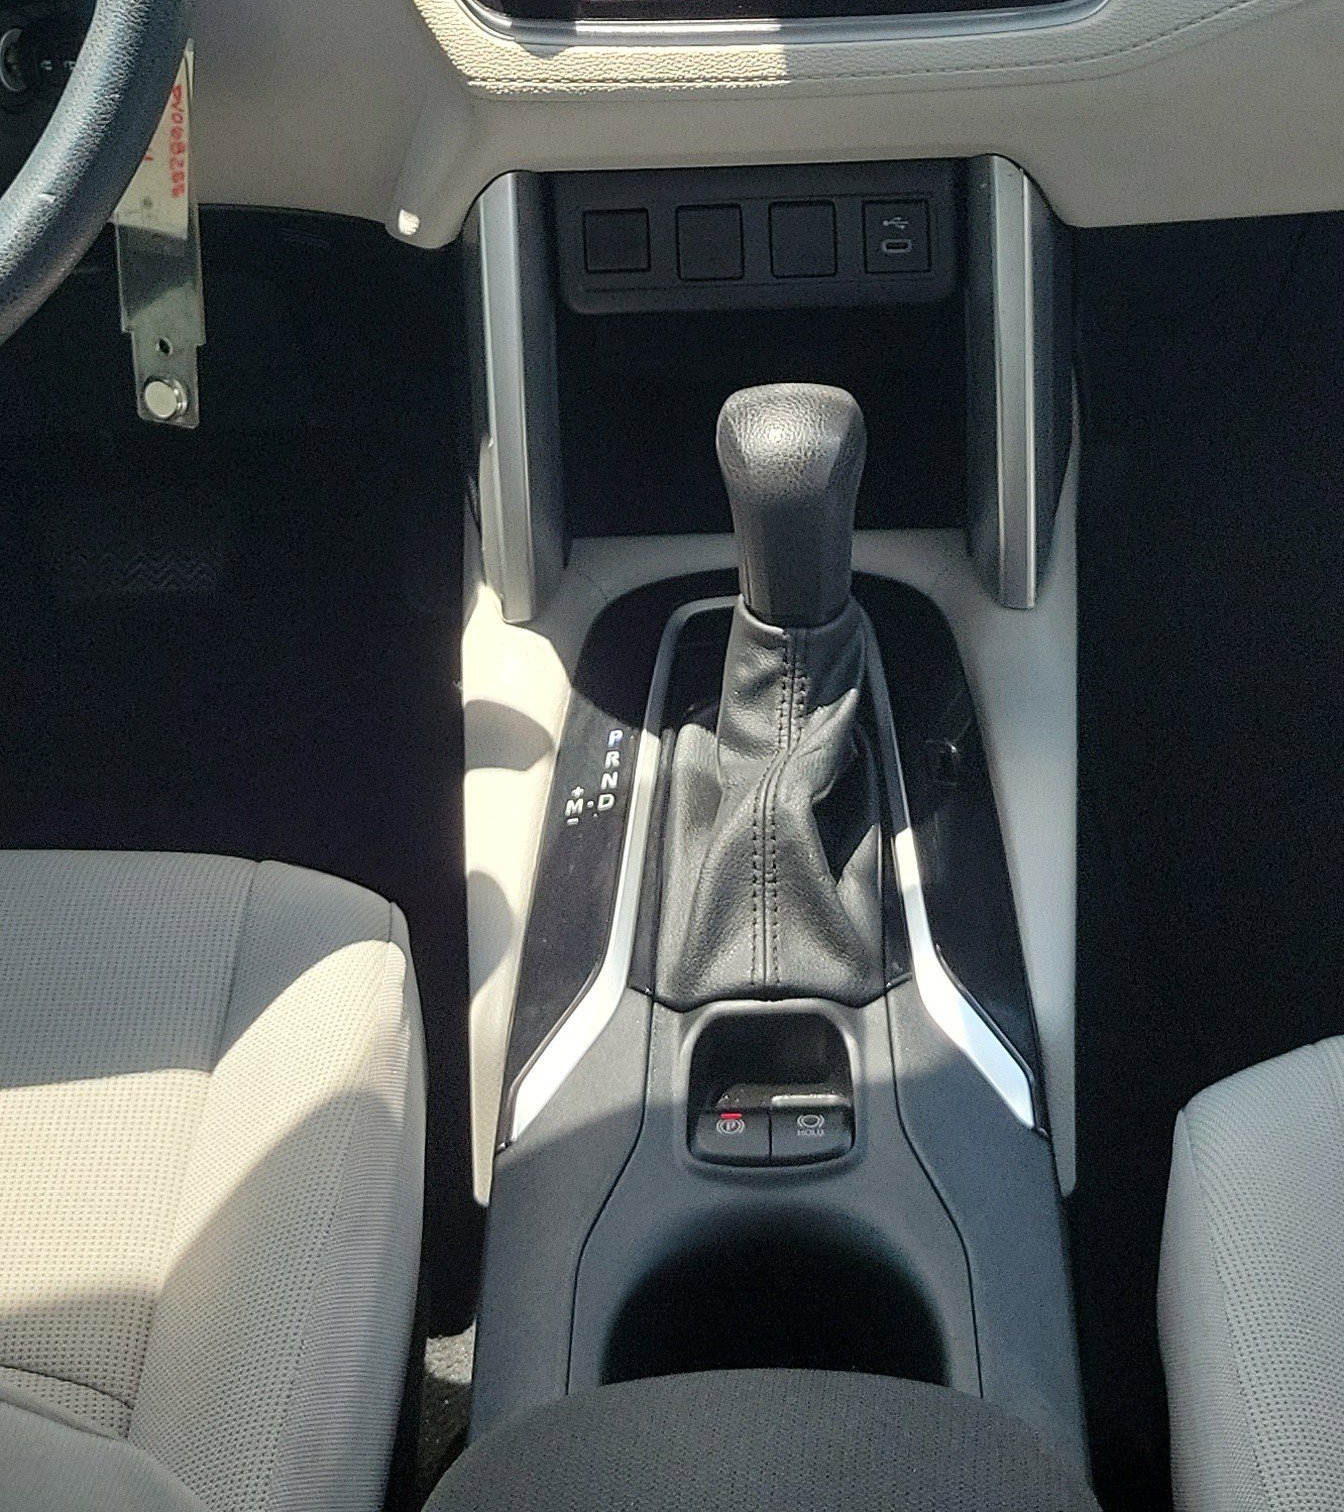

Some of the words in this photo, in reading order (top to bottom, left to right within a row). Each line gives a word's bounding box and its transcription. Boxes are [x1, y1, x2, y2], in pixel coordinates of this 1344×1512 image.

[608, 729, 623, 748] P
[604, 750, 620, 768] R
[600, 771, 619, 789] N
[564, 797, 584, 817] M
[597, 793, 615, 811] D
[798, 1128, 825, 1137] HOLD
